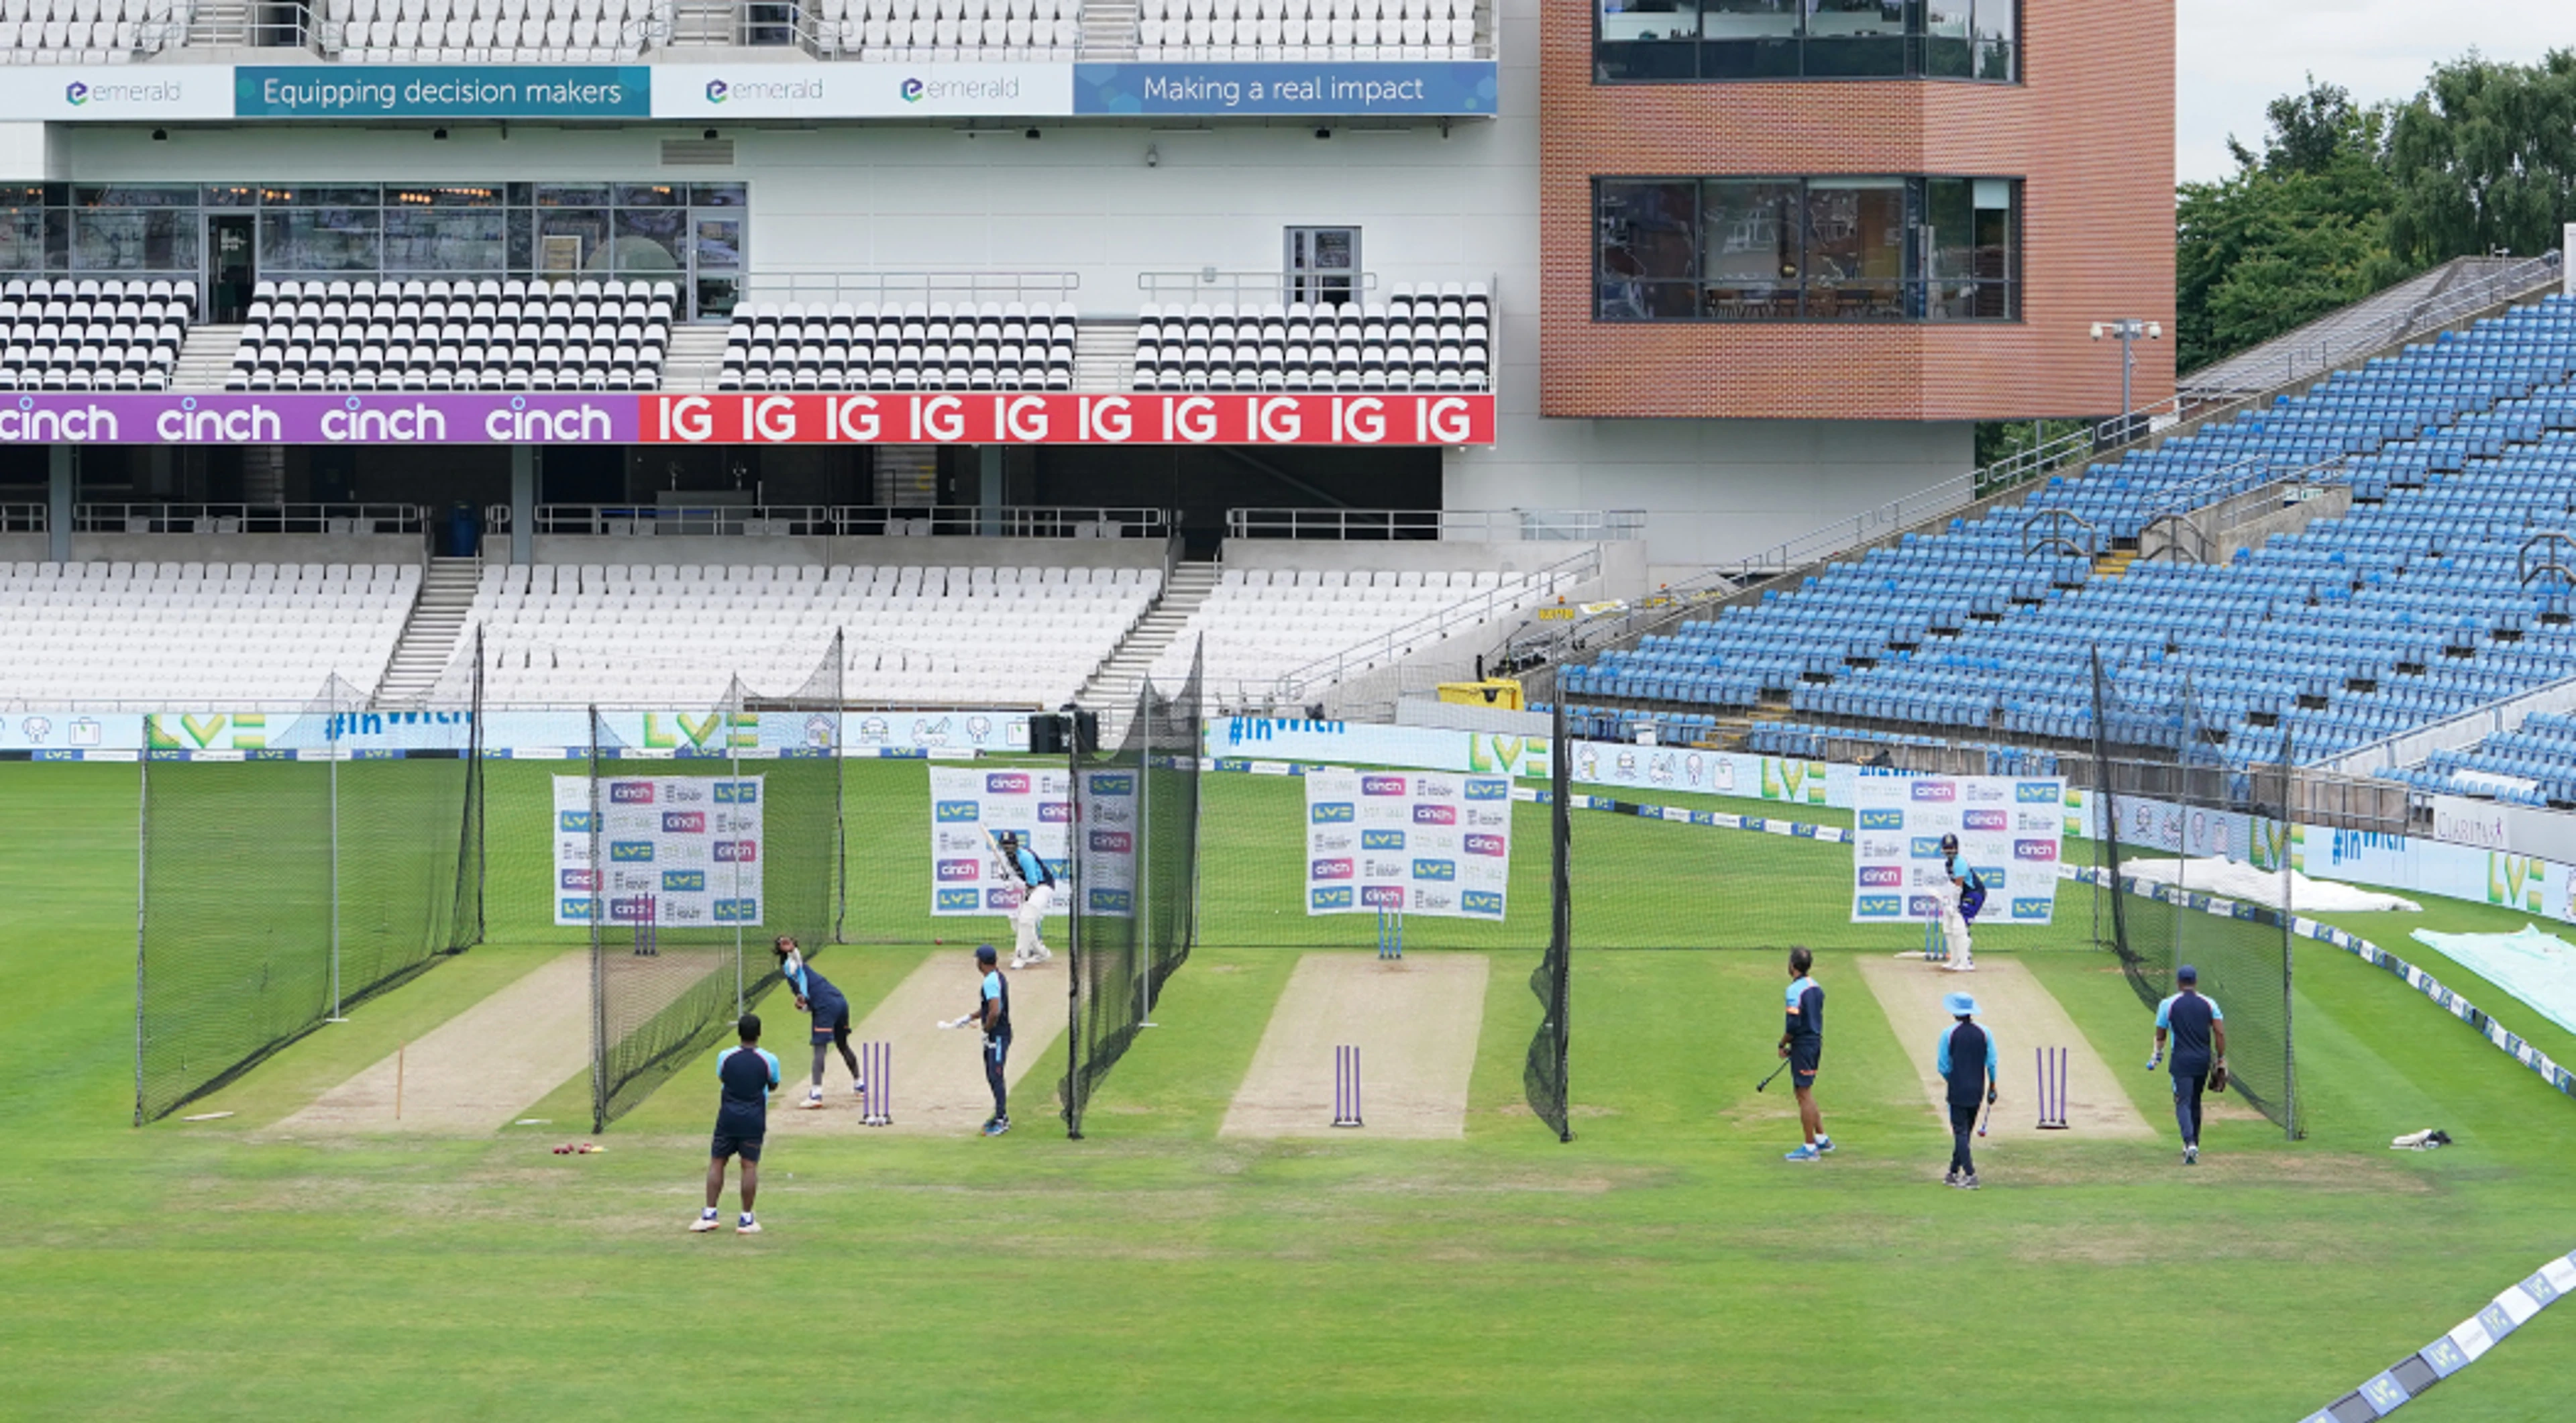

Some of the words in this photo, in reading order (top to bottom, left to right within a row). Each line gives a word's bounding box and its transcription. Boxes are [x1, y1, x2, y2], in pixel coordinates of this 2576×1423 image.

[93, 81, 180, 101] emerald
[264, 78, 396, 109] Equipping
[404, 78, 516, 103] decision
[526, 78, 622, 104] makers
[733, 78, 823, 99] emerald
[927, 76, 1019, 99] emerald
[1144, 76, 1240, 107] Making
[1248, 82, 1264, 100] a
[1273, 76, 1322, 100] real
[1331, 76, 1424, 106] impact
[0, 396, 117, 441] cinch
[157, 396, 281, 441] cinch
[321, 396, 445, 441] cinch
[486, 396, 611, 441] cinch
[660, 396, 712, 441] IG
[743, 396, 796, 441] IG
[827, 396, 880, 441] IG
[912, 396, 964, 441] IG
[996, 396, 1048, 441] IG
[1079, 396, 1132, 441] IG
[1163, 396, 1217, 441] IG
[1248, 396, 1301, 441] IG
[1332, 396, 1385, 441] IG
[1417, 396, 1470, 441] IG
